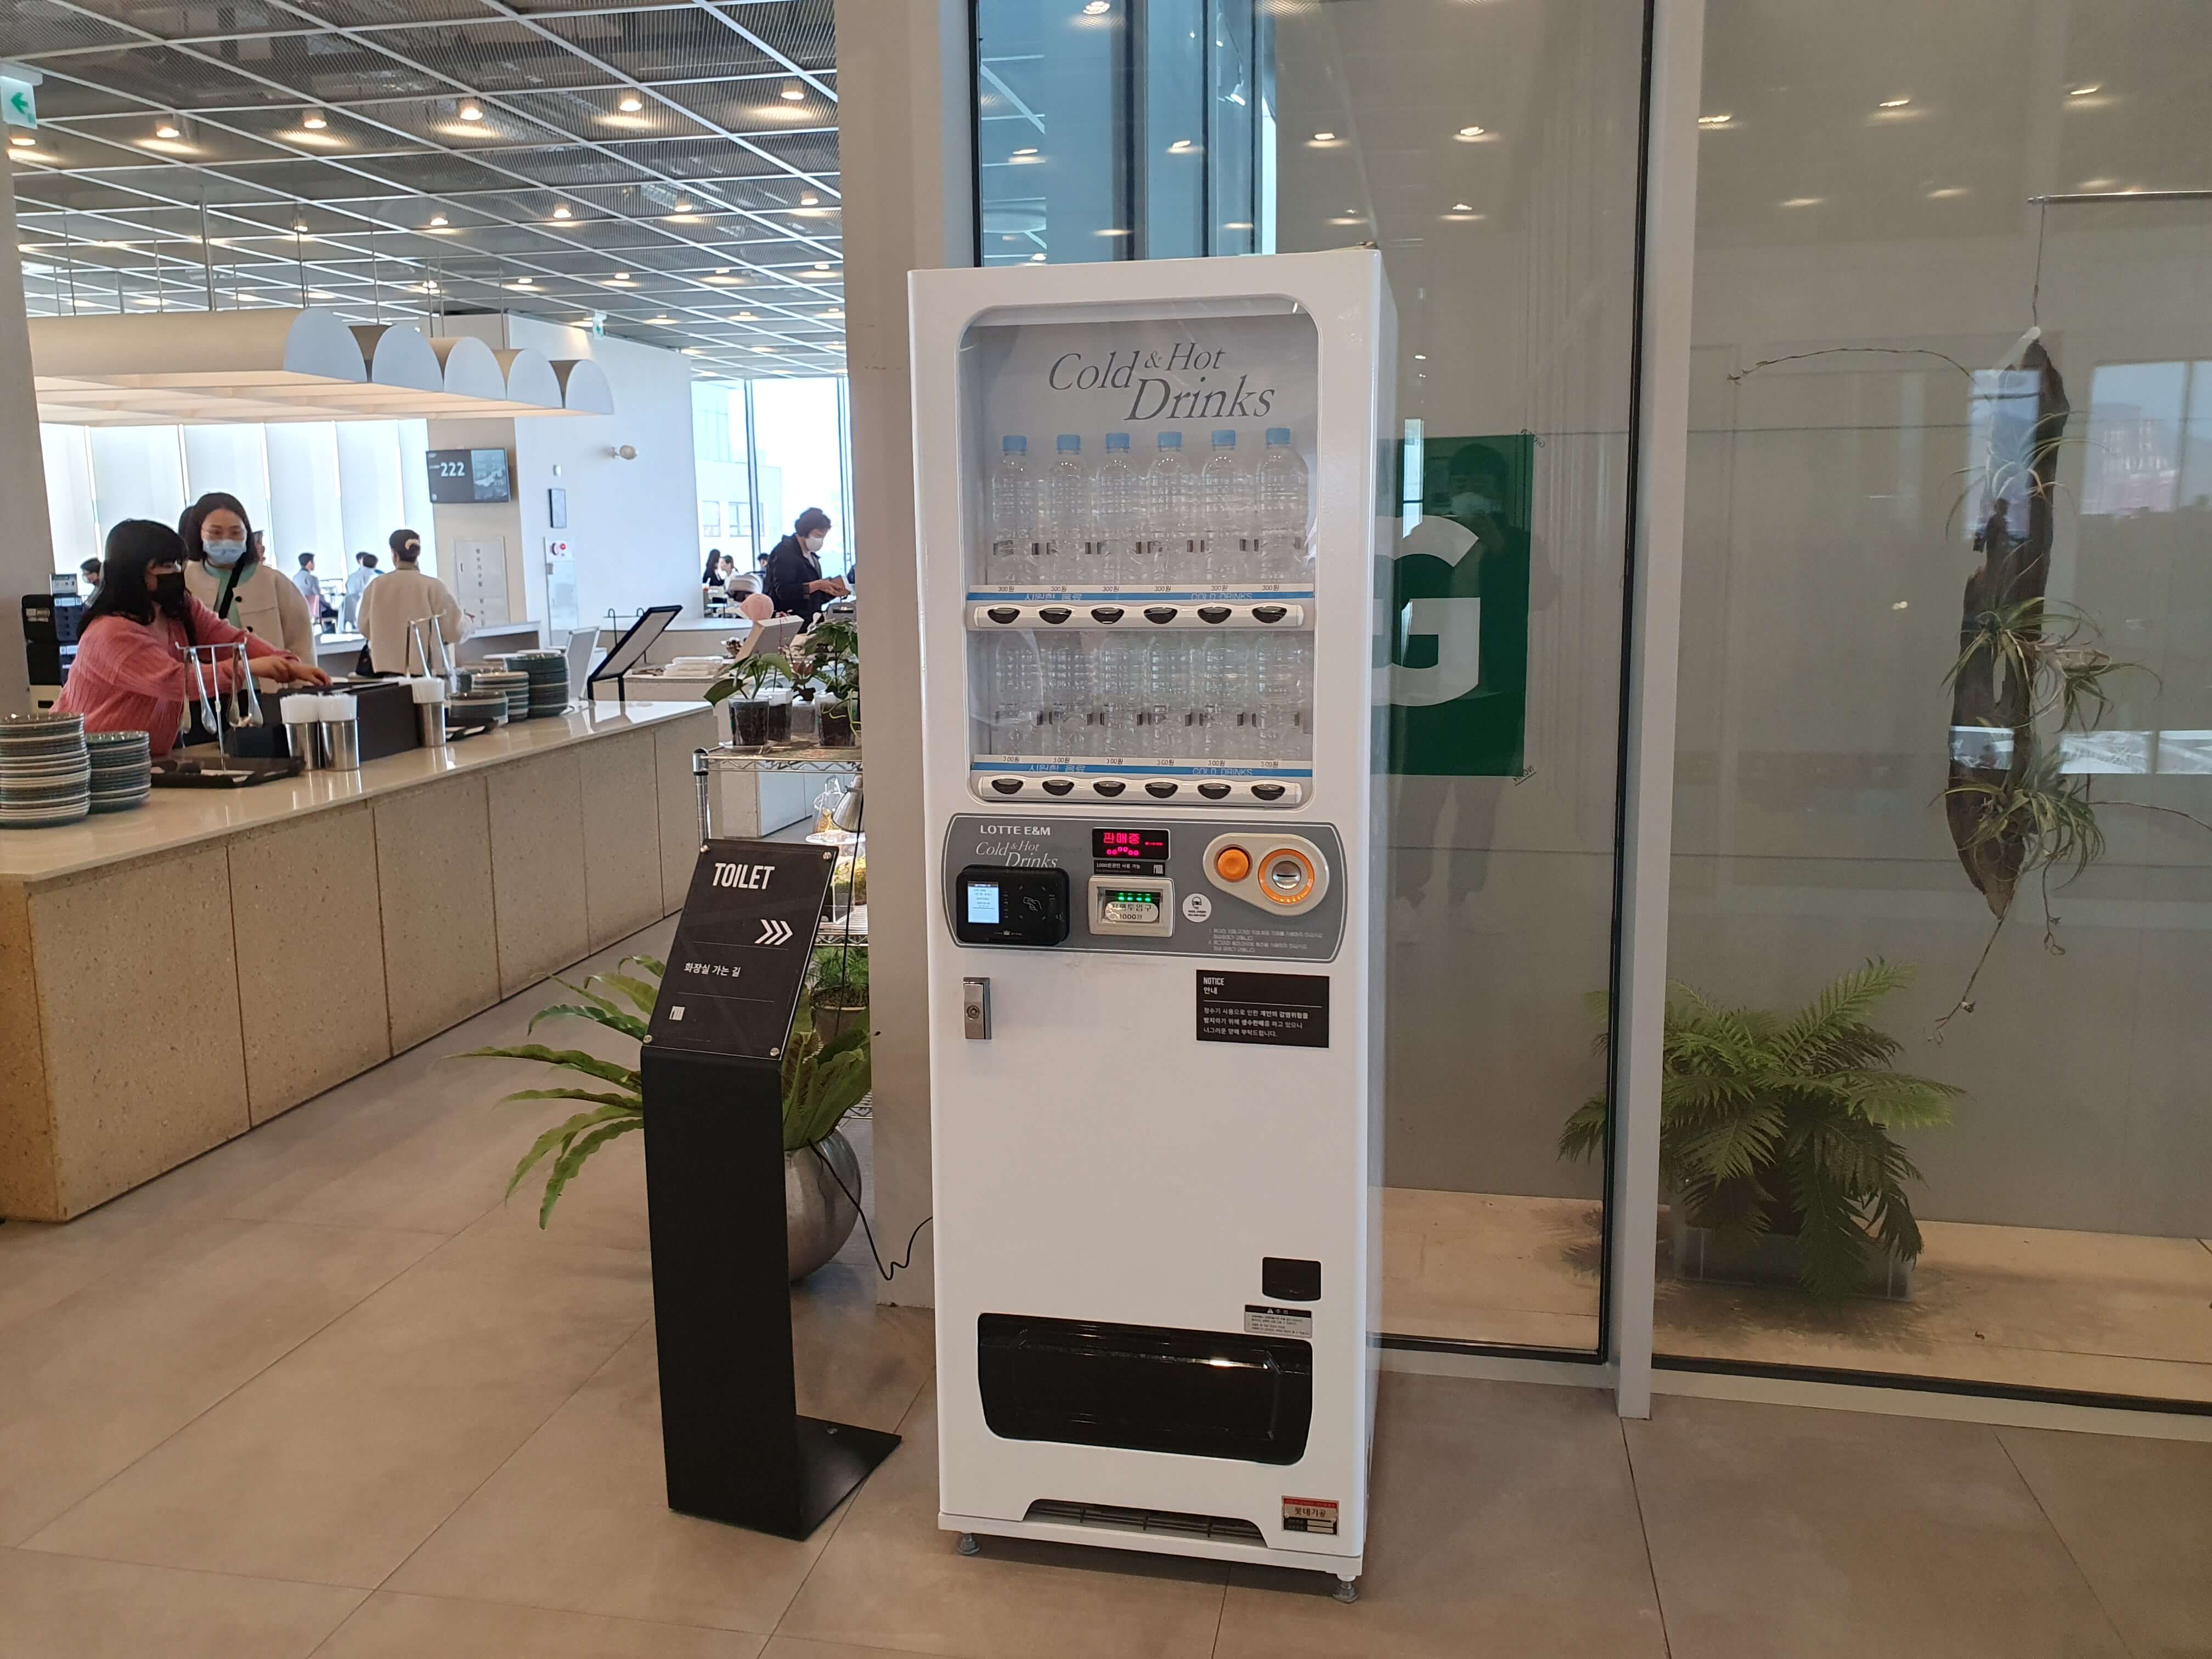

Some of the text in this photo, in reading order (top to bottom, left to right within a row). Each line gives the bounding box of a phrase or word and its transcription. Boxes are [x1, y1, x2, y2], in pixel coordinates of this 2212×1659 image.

[1049, 342, 1226, 390] Cold & Hot
[1123, 374, 1276, 421] Drinks
[441, 461, 465, 477] 222
[980, 825, 1051, 836] LOTTE E&M
[1103, 832, 1140, 845] 판매중
[976, 841, 1009, 856] Cold
[1018, 840, 1040, 851] Hot
[1005, 851, 1058, 868] Drinks
[712, 862, 776, 890] TOILET
[684, 962, 741, 978] 화장실 가는 길
[1203, 977, 1225, 986] NOTICE
[1203, 986, 1218, 995] 안내
[1295, 1506, 1326, 1518] 롯데기공
